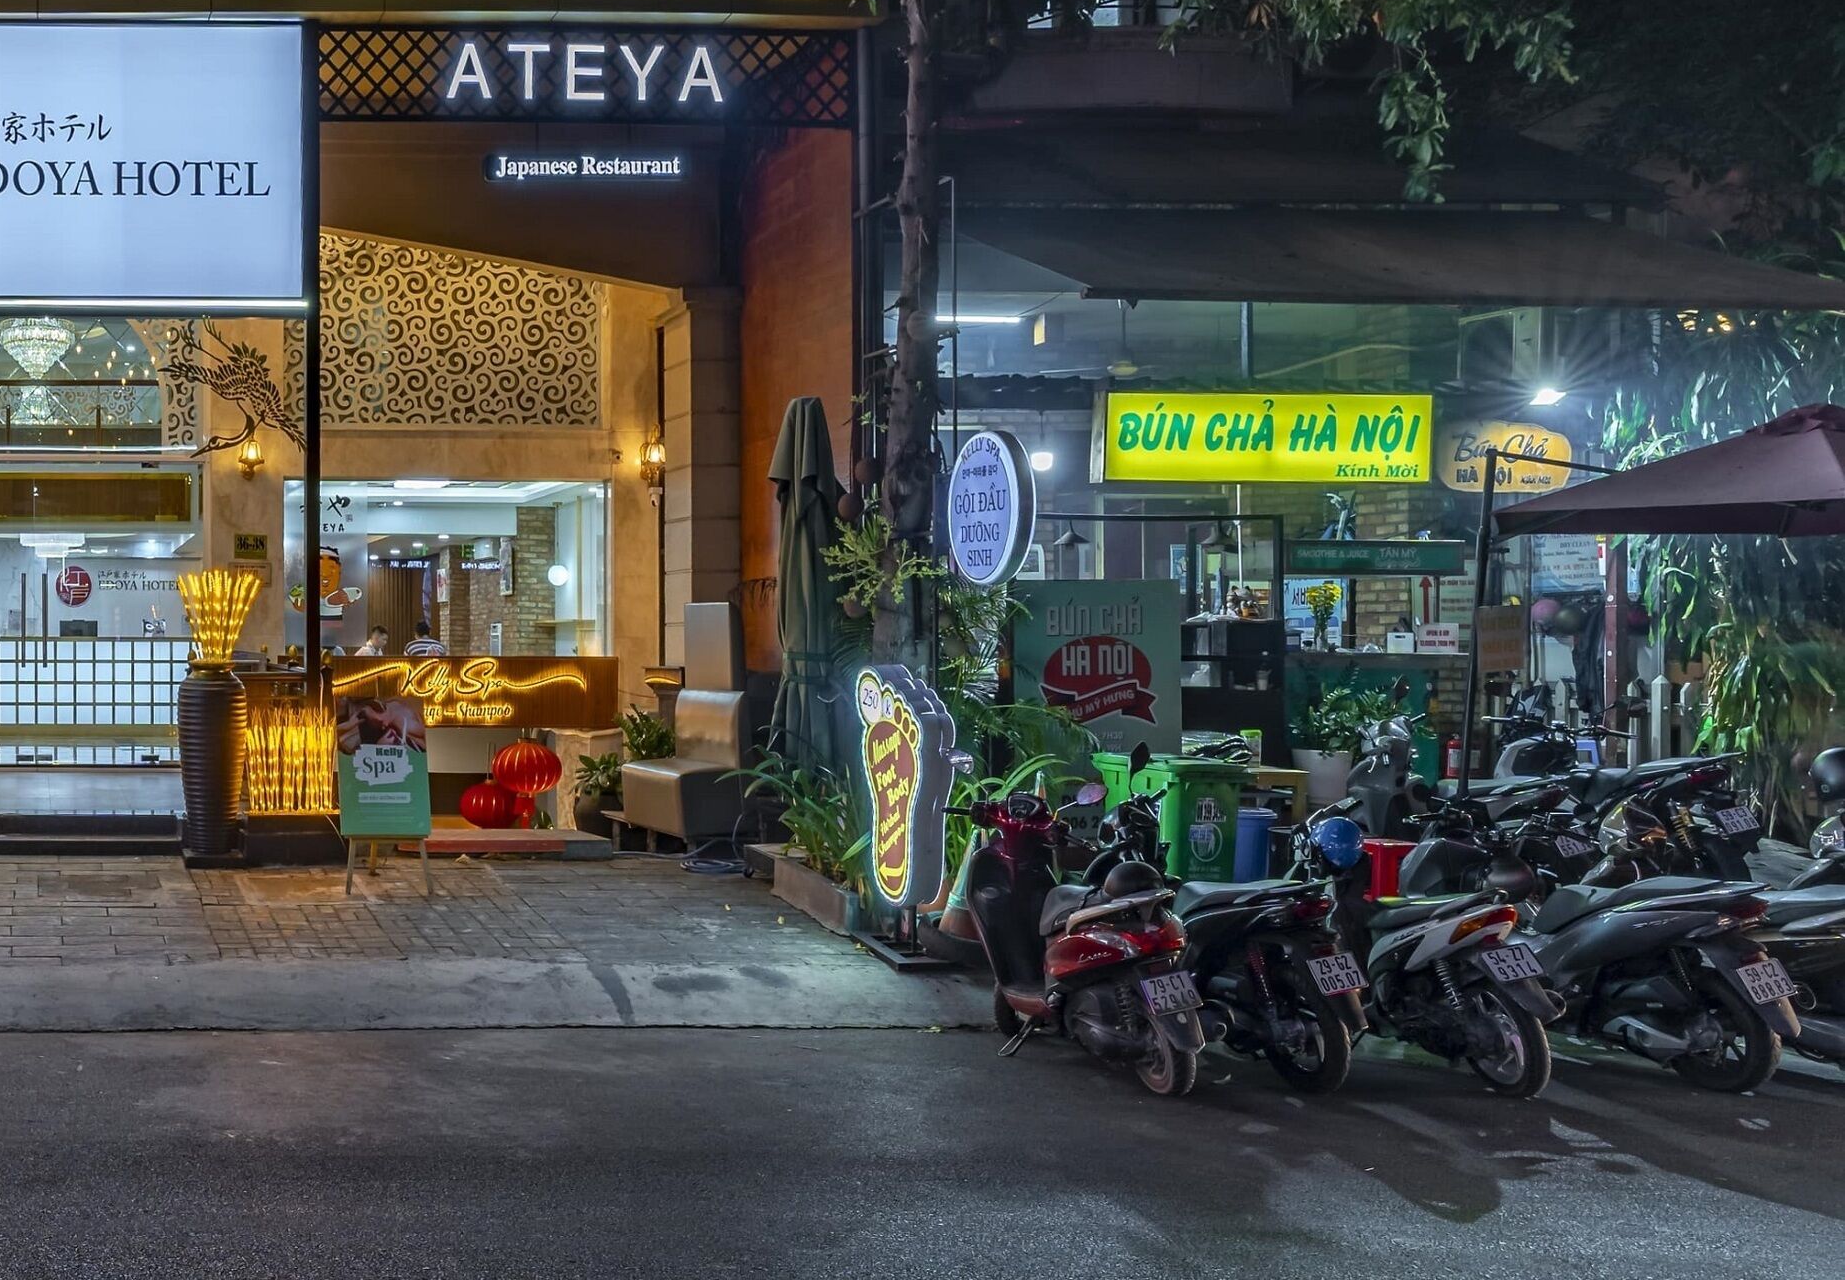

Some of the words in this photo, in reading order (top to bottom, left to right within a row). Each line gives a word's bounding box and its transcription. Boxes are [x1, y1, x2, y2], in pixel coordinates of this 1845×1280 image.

[446, 43, 723, 102] ATEYA
[112, 160, 271, 197] HOTEL
[495, 156, 577, 180] Japanese
[581, 155, 680, 176] Restaurant
[1117, 401, 1195, 451] BÚN
[1205, 399, 1275, 451] CHẢ
[1288, 403, 1337, 452] HÀ
[1350, 405, 1421, 461] NỘI
[961, 436, 985, 465] KELLY
[986, 438, 1001, 463] SPA
[1335, 463, 1379, 478] Kính
[1385, 464, 1419, 478] Mời
[1456, 466, 1479, 482] HÀ
[954, 488, 975, 519] GỘI
[978, 482, 1007, 513] ĐẦU
[960, 521, 1000, 544] DƯỠNG
[967, 549, 993, 567] SINH
[1046, 597, 1092, 637] BÚN
[1099, 595, 1143, 636] CHẢ
[1062, 638, 1091, 677] HÀ
[1099, 639, 1134, 680] NỘI
[862, 688, 879, 709] 250
[362, 757, 396, 780] Spa
[874, 764, 897, 792] Foot
[887, 777, 910, 808] Body
[1320, 970, 1362, 992] 005.07
